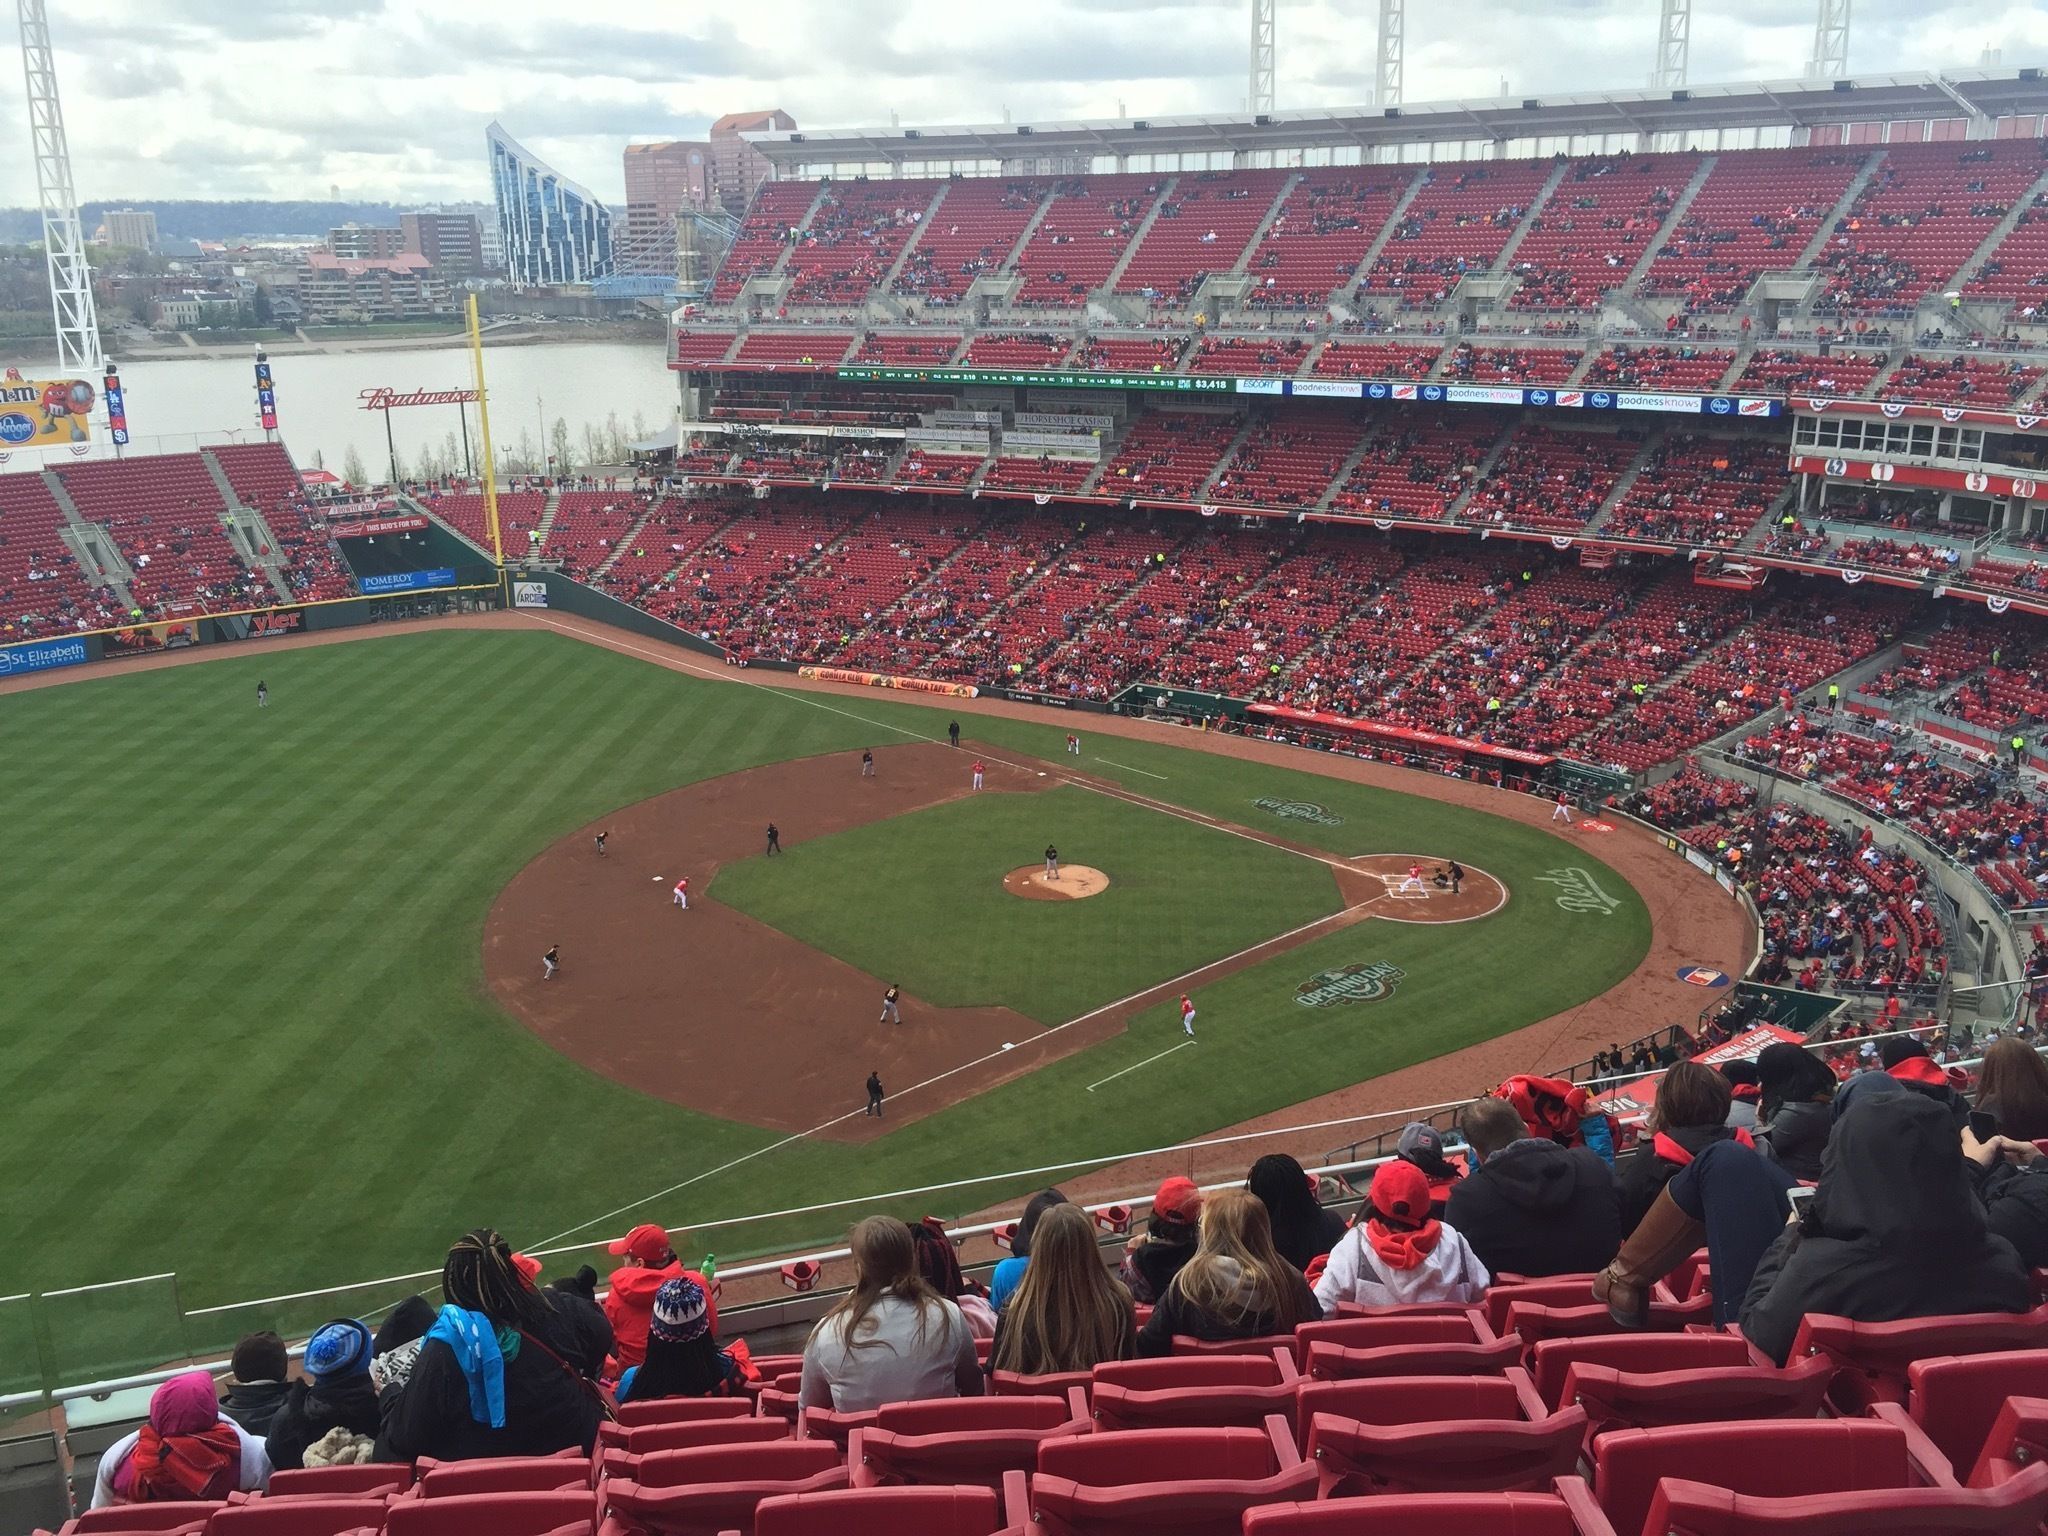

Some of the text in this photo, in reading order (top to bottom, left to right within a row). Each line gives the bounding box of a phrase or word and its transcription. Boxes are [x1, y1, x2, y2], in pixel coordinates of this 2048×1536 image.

[1195, 380, 1226, 389] $3,418
[1243, 379, 1274, 388] ESCORT
[356, 387, 490, 411] Budweiser
[1741, 401, 1768, 413] Combos
[1024, 414, 1110, 426] HORSESHOE CASINO
[836, 427, 874, 435] HORSESHOE
[1827, 461, 1843, 475] 42
[1879, 465, 1885, 479] 1
[1971, 474, 1981, 490] 5
[2015, 480, 2033, 497] 20
[366, 523, 380, 532] THIS
[399, 520, 410, 529] FOR
[365, 573, 414, 586] POMEROY
[28, 643, 84, 662] Elizabeth
[29, 654, 85, 667] HEALTHCARE
[819, 671, 847, 682] GORILLA
[901, 680, 947, 693] GORILLA TAPE
[1532, 867, 1621, 915] Reds
[1296, 960, 1397, 1006] OPENING DAY
